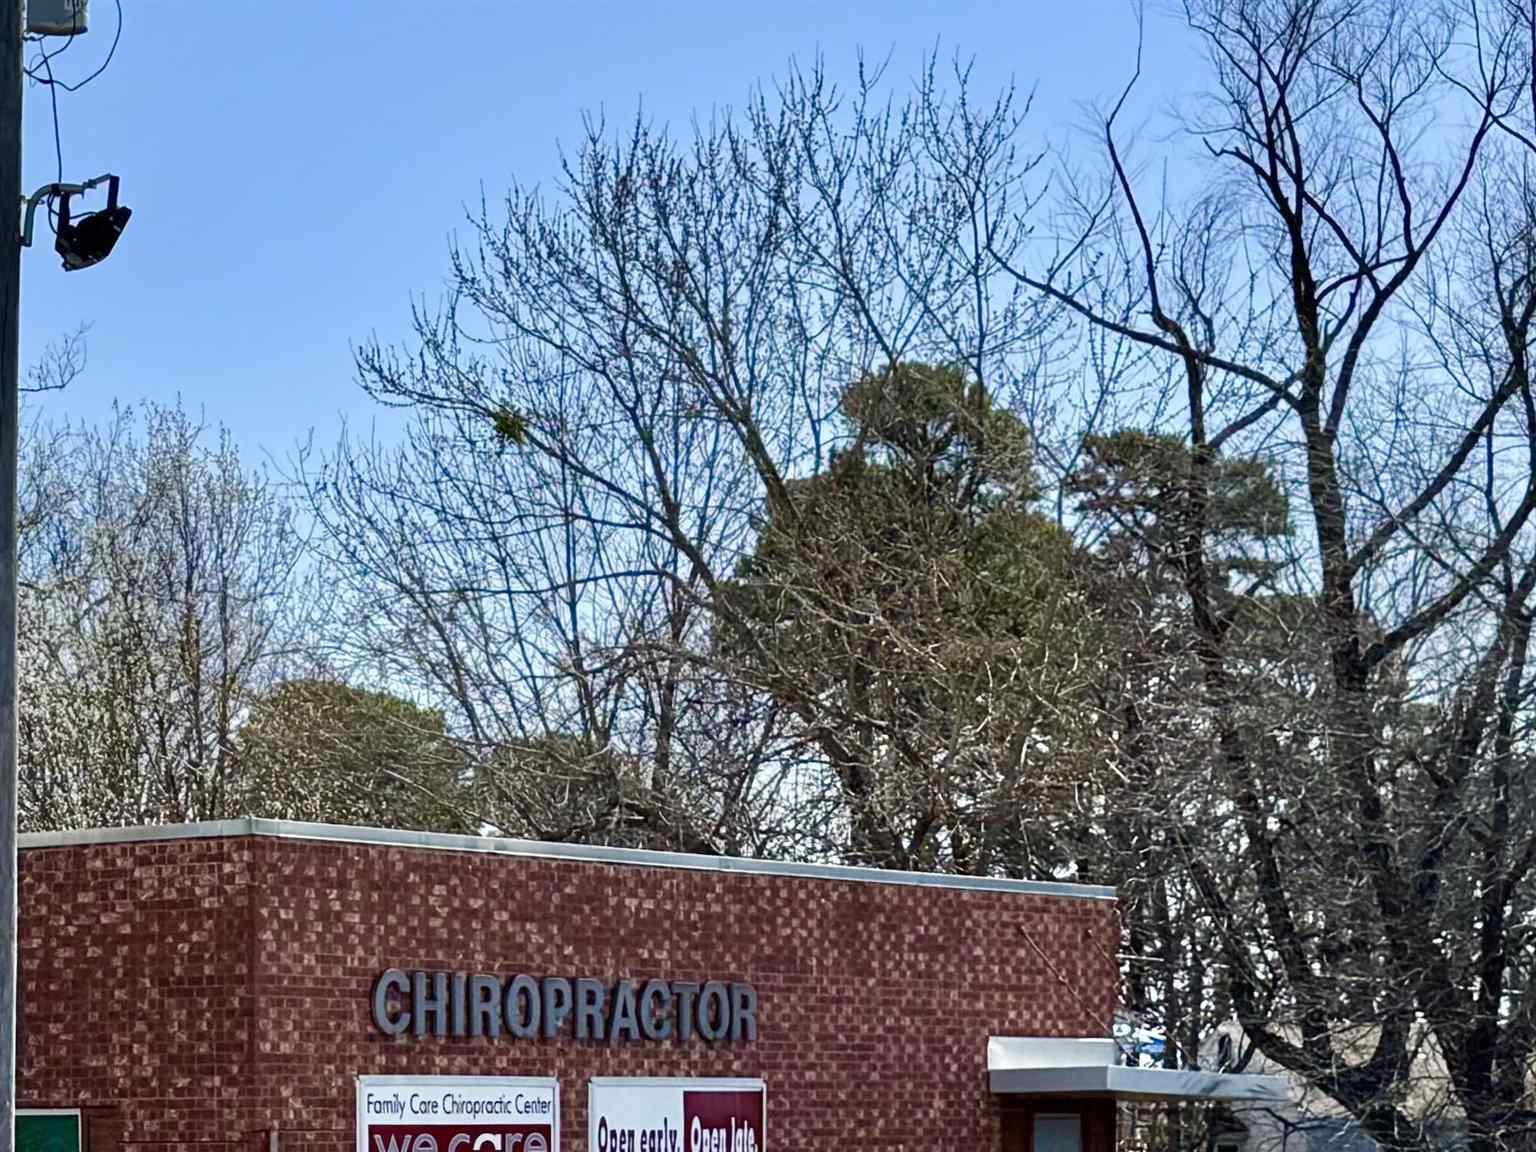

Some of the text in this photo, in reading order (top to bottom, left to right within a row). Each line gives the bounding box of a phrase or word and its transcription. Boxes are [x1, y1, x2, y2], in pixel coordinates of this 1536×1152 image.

[374, 968, 757, 1043] CHIROPRACTOR
[366, 1093, 552, 1120] Family Care Chiropractic Center
